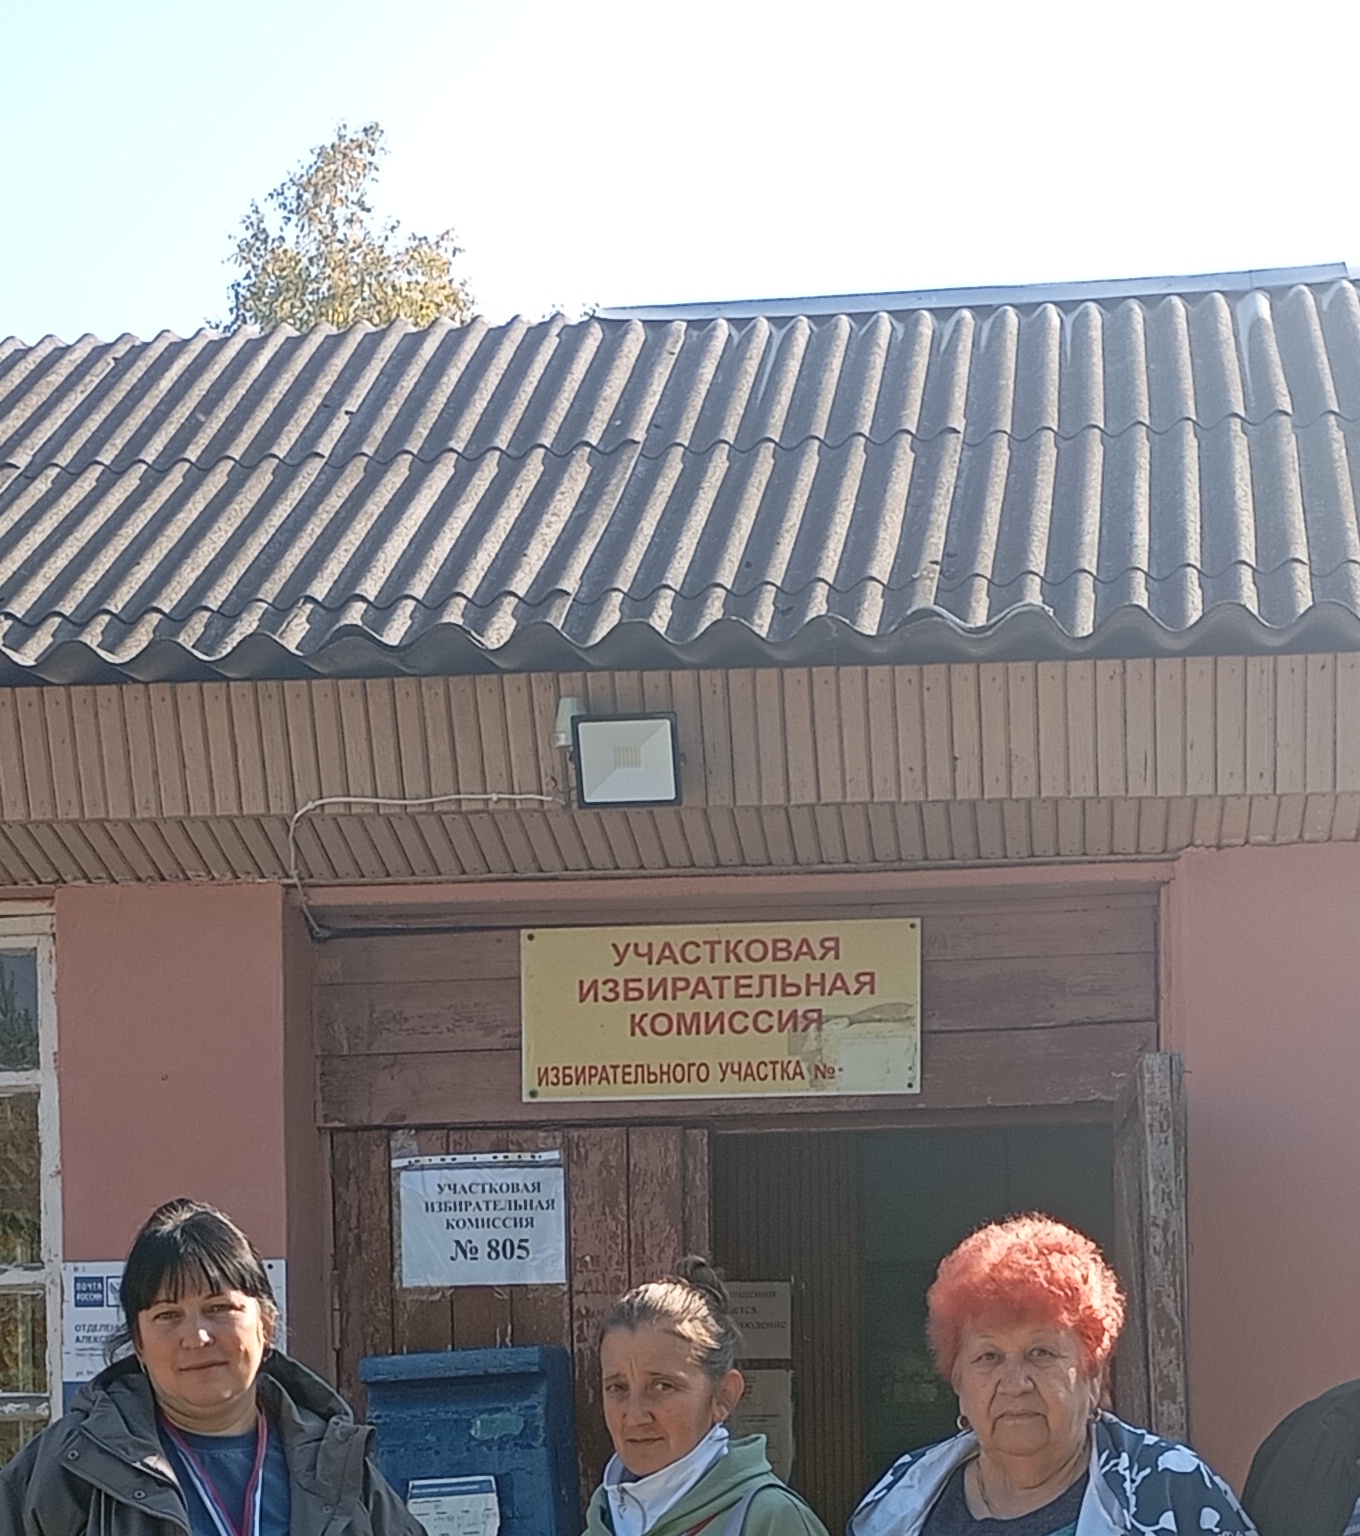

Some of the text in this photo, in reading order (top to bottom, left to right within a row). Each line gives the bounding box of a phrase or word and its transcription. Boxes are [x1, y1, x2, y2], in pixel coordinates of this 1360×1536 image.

[611, 936, 841, 967] УЧАСТКОВАЯ
[578, 971, 876, 1004] ИЗБИРАТЕЛЬНАЯ
[629, 1008, 824, 1037] КОМИССИЯ
[537, 1060, 836, 1088] ИЗБИРАТЕЛЬНОГО УЧАСТКА №
[436, 1182, 541, 1195] УЧАСТКОВАЯ
[424, 1198, 556, 1213] ИЗБИРАТЕЛЬНАЯ
[445, 1216, 535, 1230] КОМИССИЯ
[449, 1238, 530, 1262] № 805
